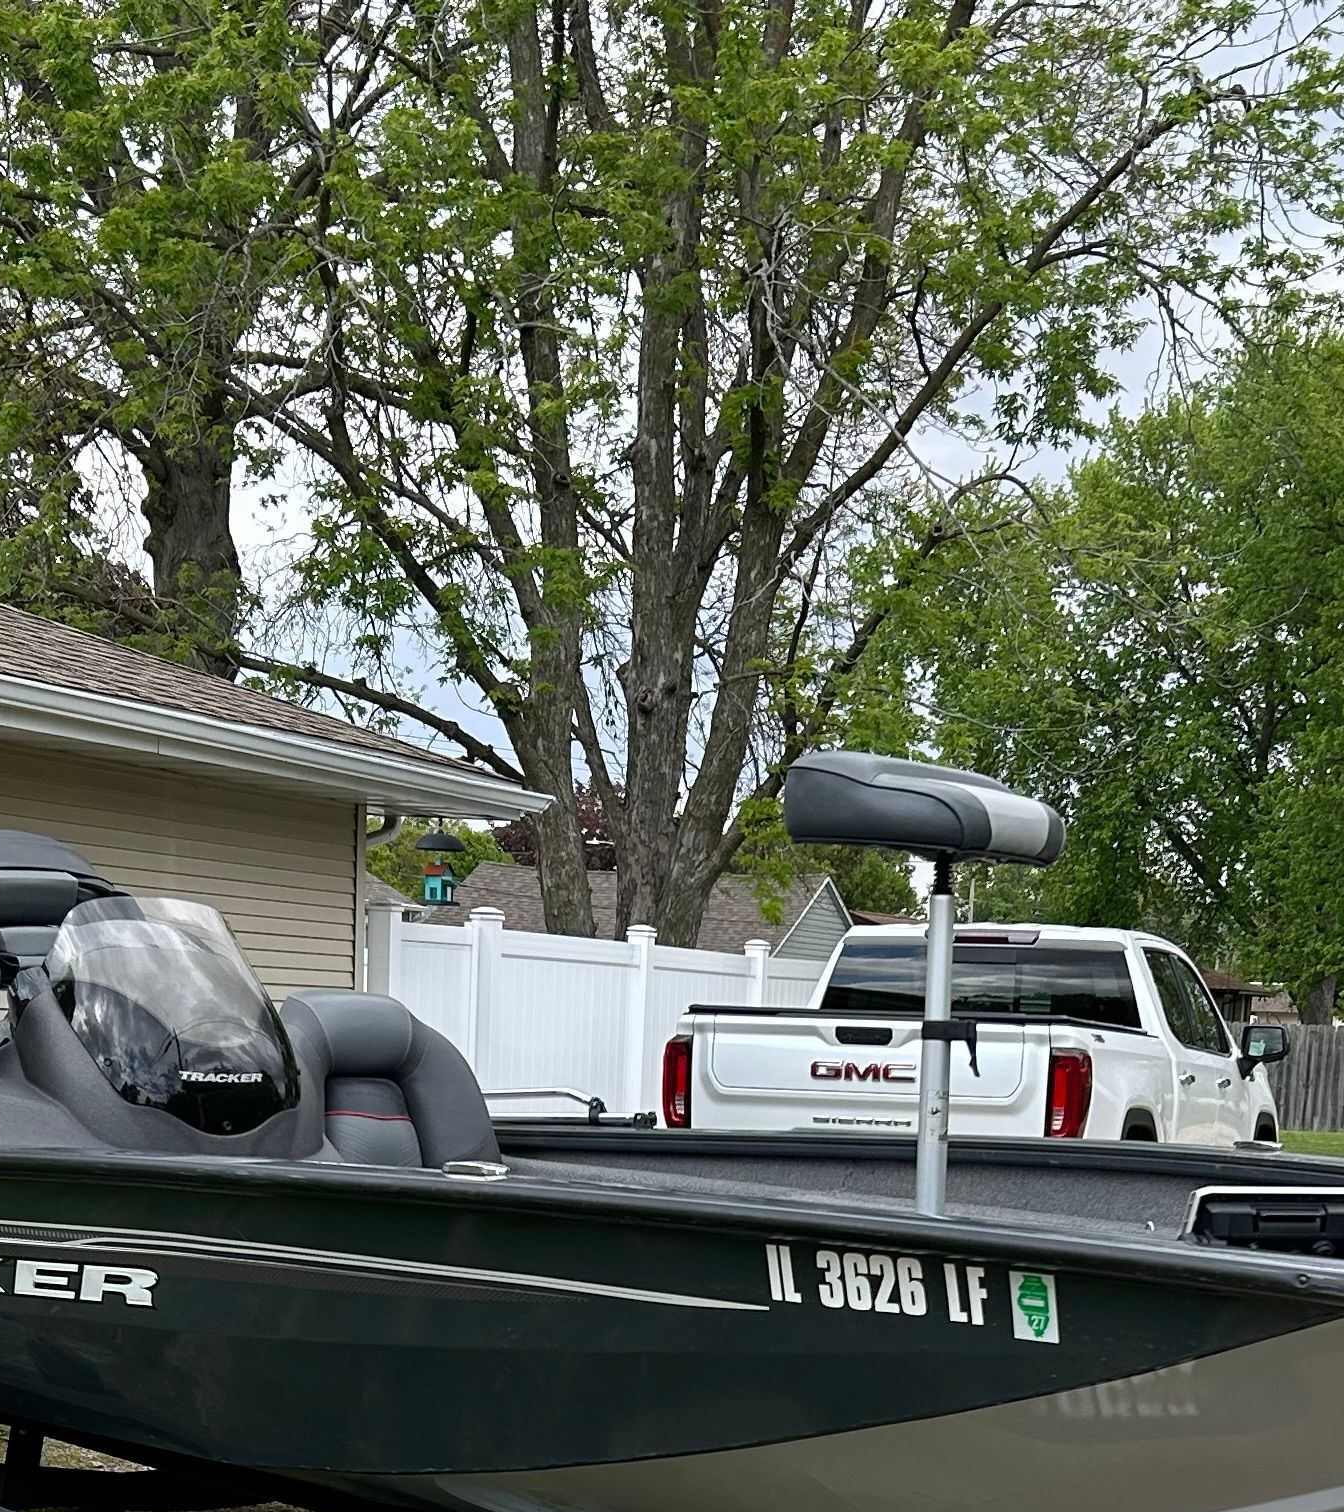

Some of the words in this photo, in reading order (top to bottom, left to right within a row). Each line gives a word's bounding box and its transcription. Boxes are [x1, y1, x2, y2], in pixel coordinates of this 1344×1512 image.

[178, 1070, 263, 1083] TRACKER
[810, 1060, 917, 1083] GMC
[765, 1244, 803, 1304] IL
[816, 1250, 928, 1317] 3626
[943, 1262, 989, 1327] LF
[1030, 1314, 1046, 1332] 27
